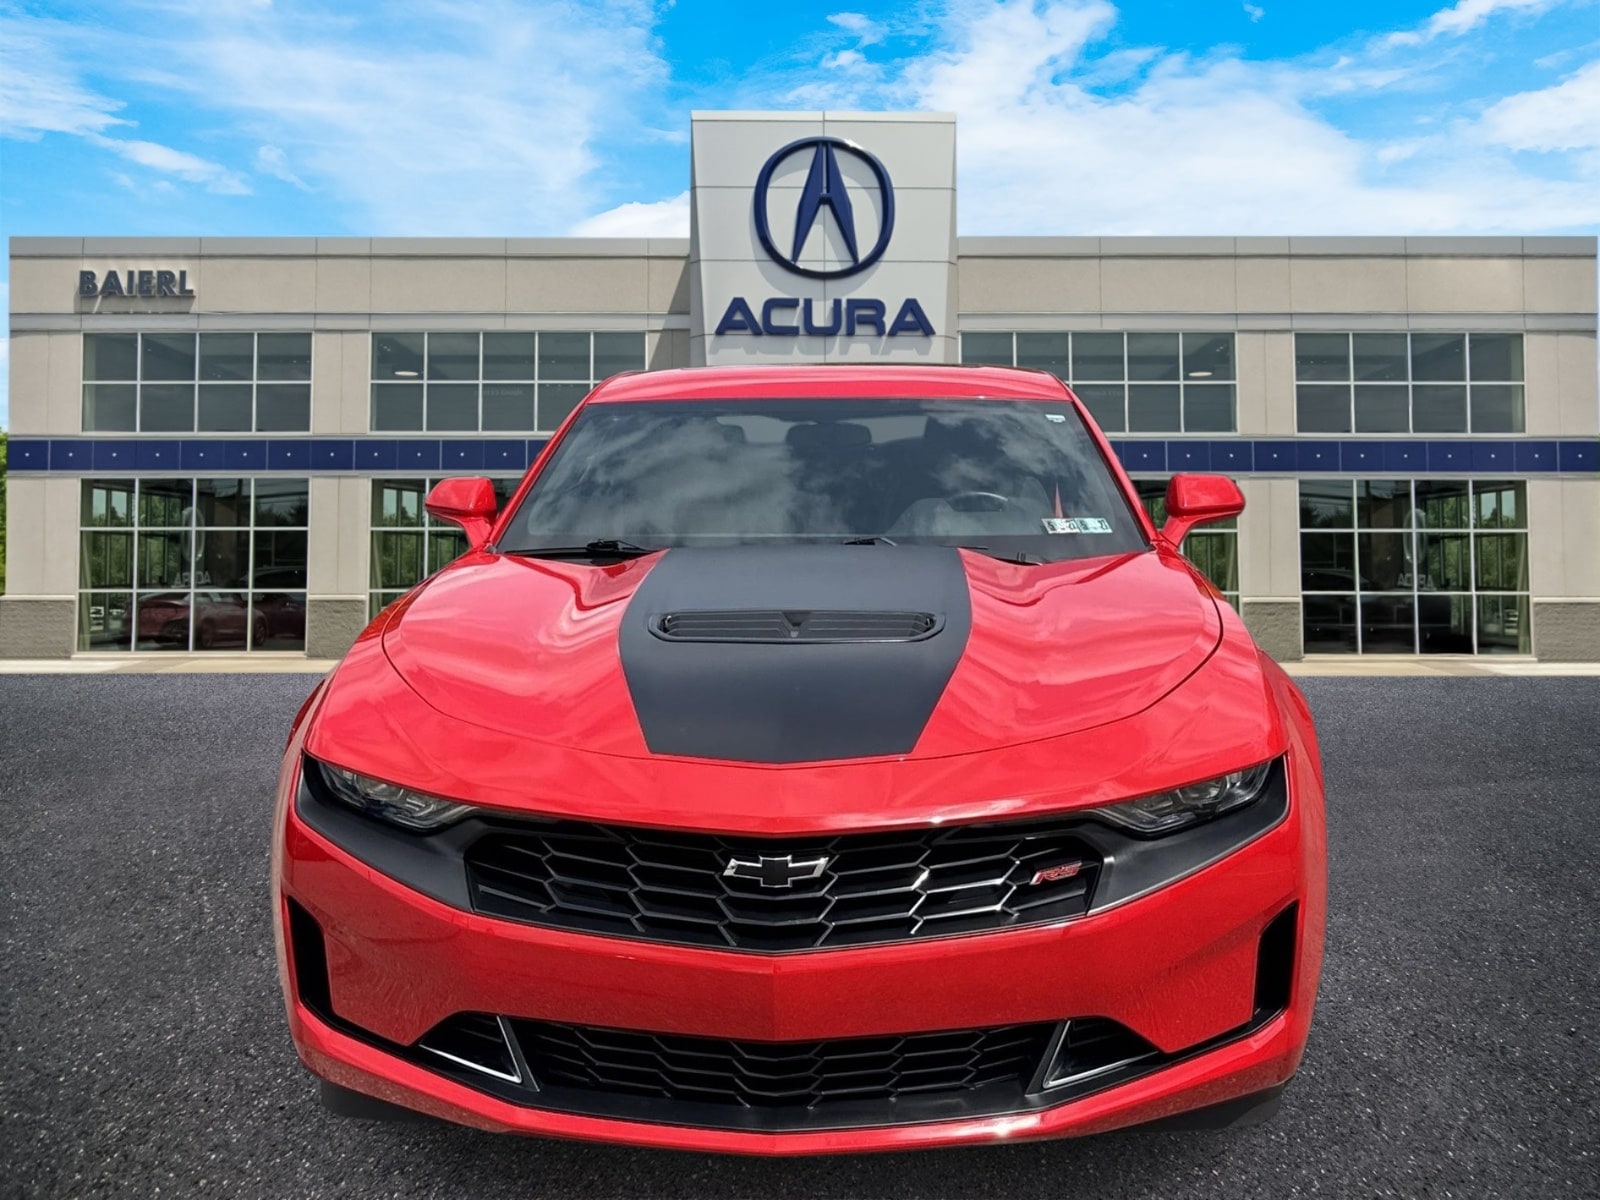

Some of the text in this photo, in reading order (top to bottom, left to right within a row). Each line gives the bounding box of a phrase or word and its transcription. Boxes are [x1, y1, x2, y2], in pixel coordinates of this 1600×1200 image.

[79, 269, 195, 297] BAIERL
[714, 296, 936, 337] ACURA
[1029, 860, 1082, 886] RS
